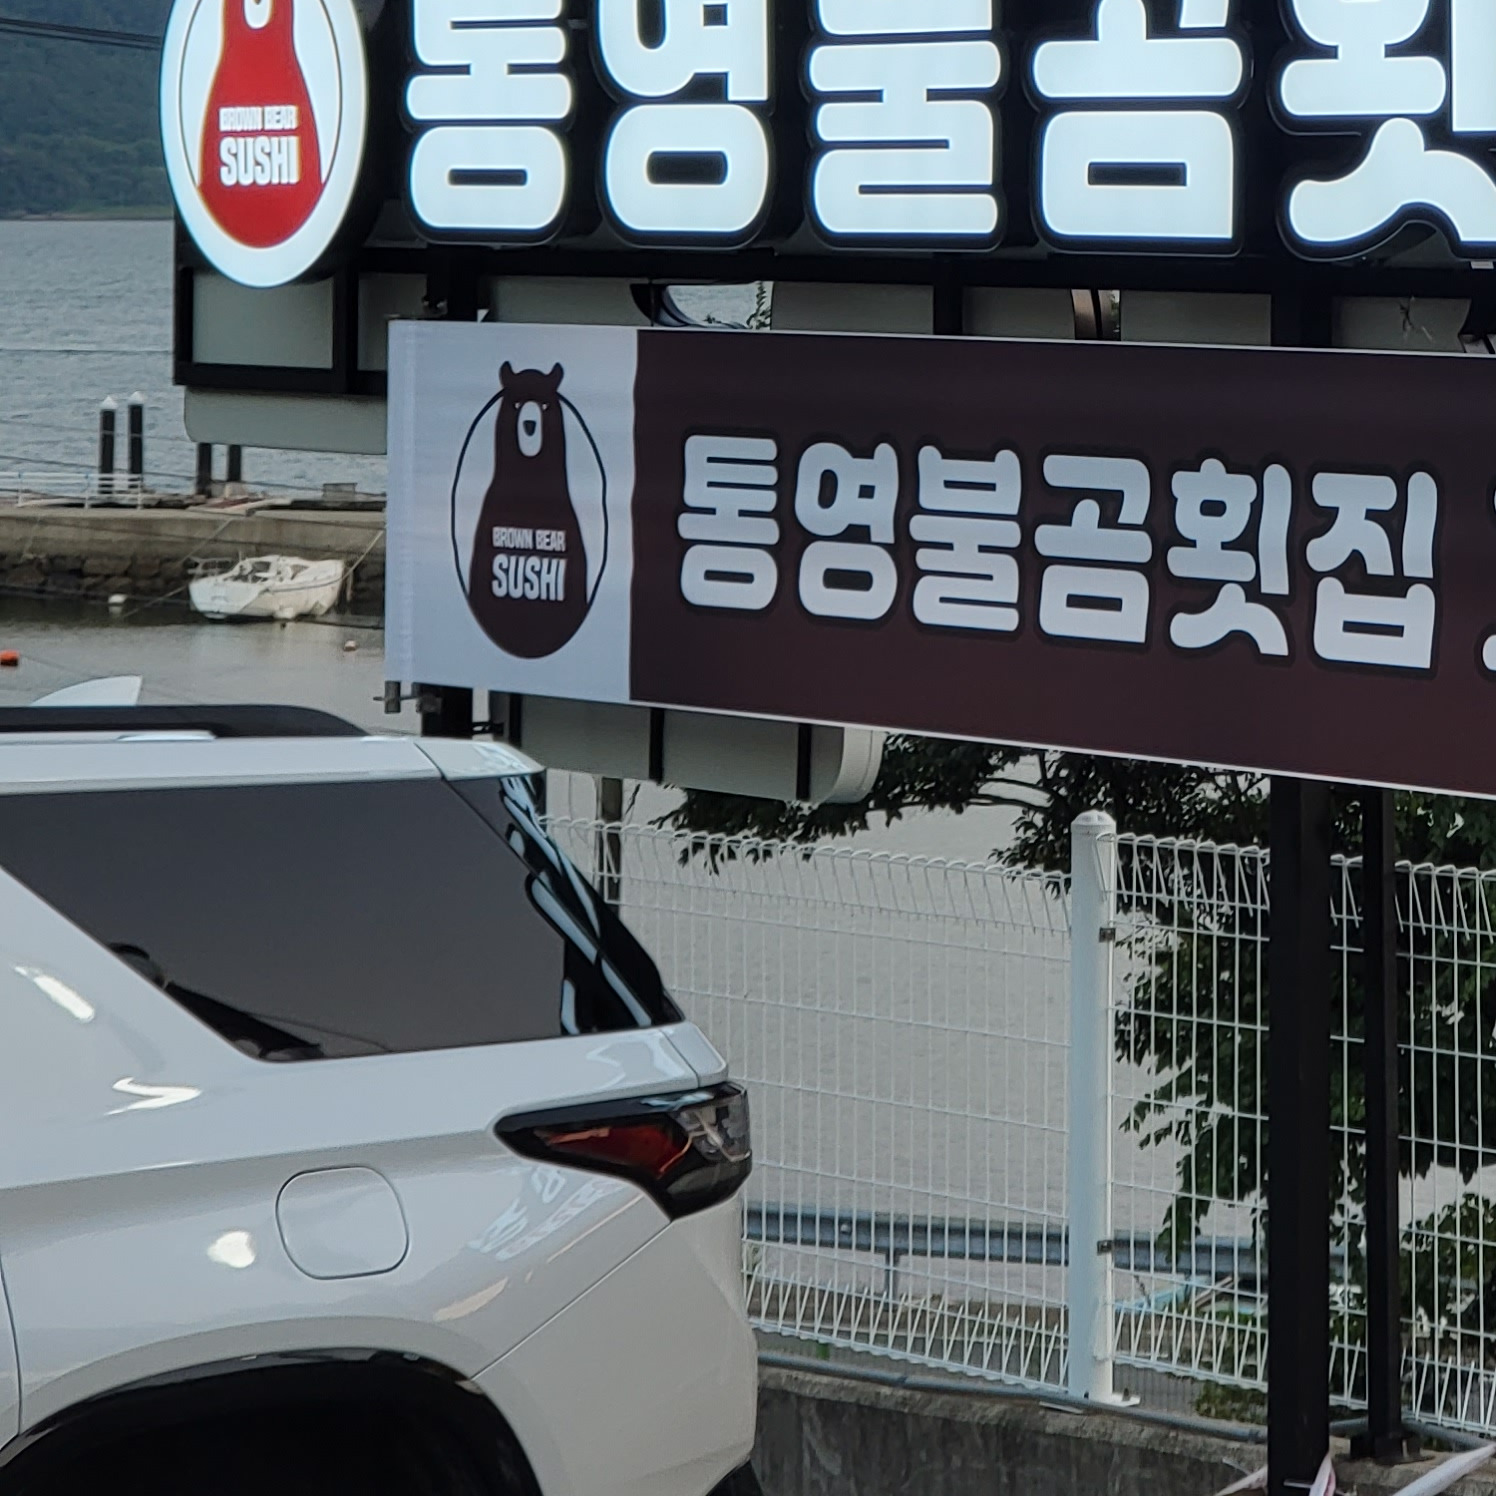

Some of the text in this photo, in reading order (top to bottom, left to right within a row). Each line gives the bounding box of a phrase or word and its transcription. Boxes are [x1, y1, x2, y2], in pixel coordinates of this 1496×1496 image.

[219, 135, 300, 186] SUSHI
[492, 526, 566, 552] BROWN BEAR
[677, 434, 1439, 670] 통영불곰횟집
[492, 553, 567, 602] SUSHI
